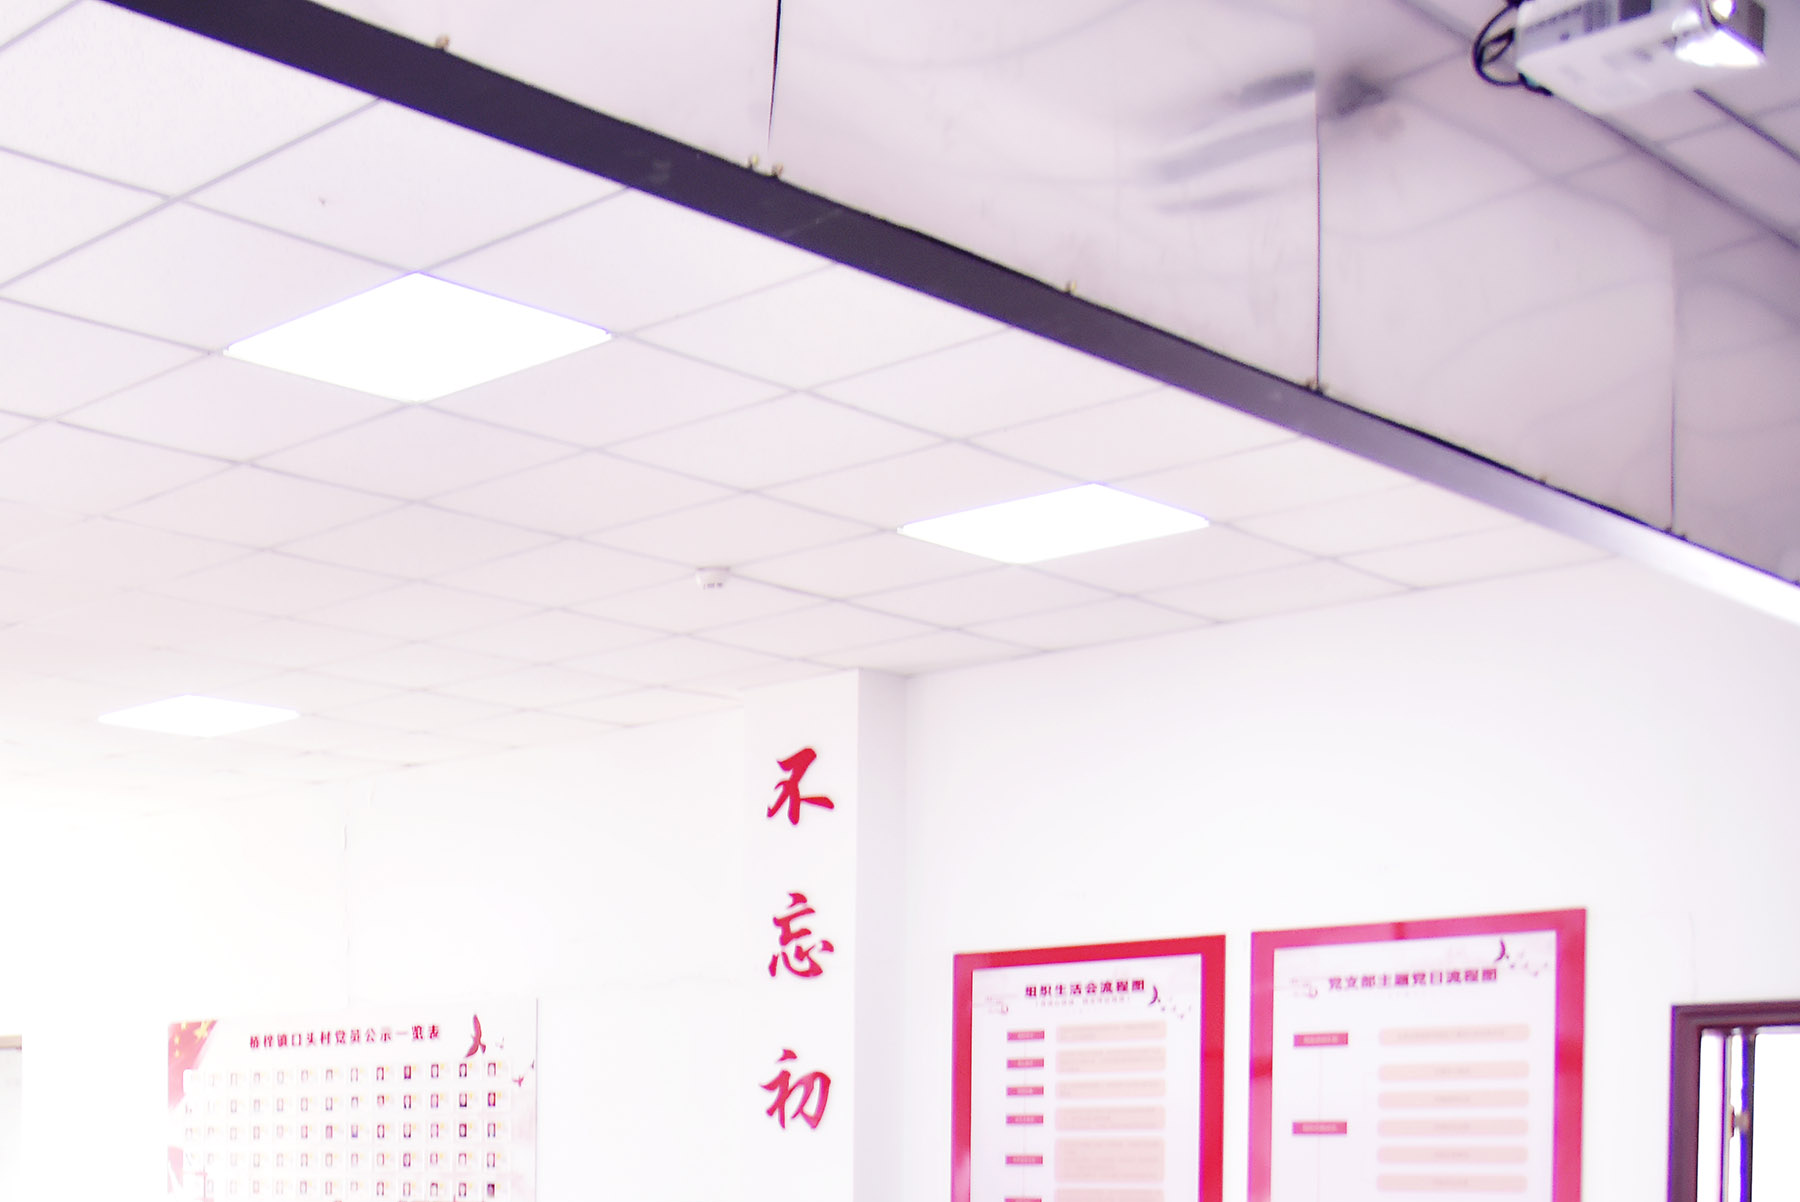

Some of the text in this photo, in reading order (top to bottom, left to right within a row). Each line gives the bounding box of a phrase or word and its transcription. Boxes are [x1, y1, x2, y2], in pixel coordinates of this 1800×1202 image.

[1024, 979, 1145, 997] 组织生活会流程图
